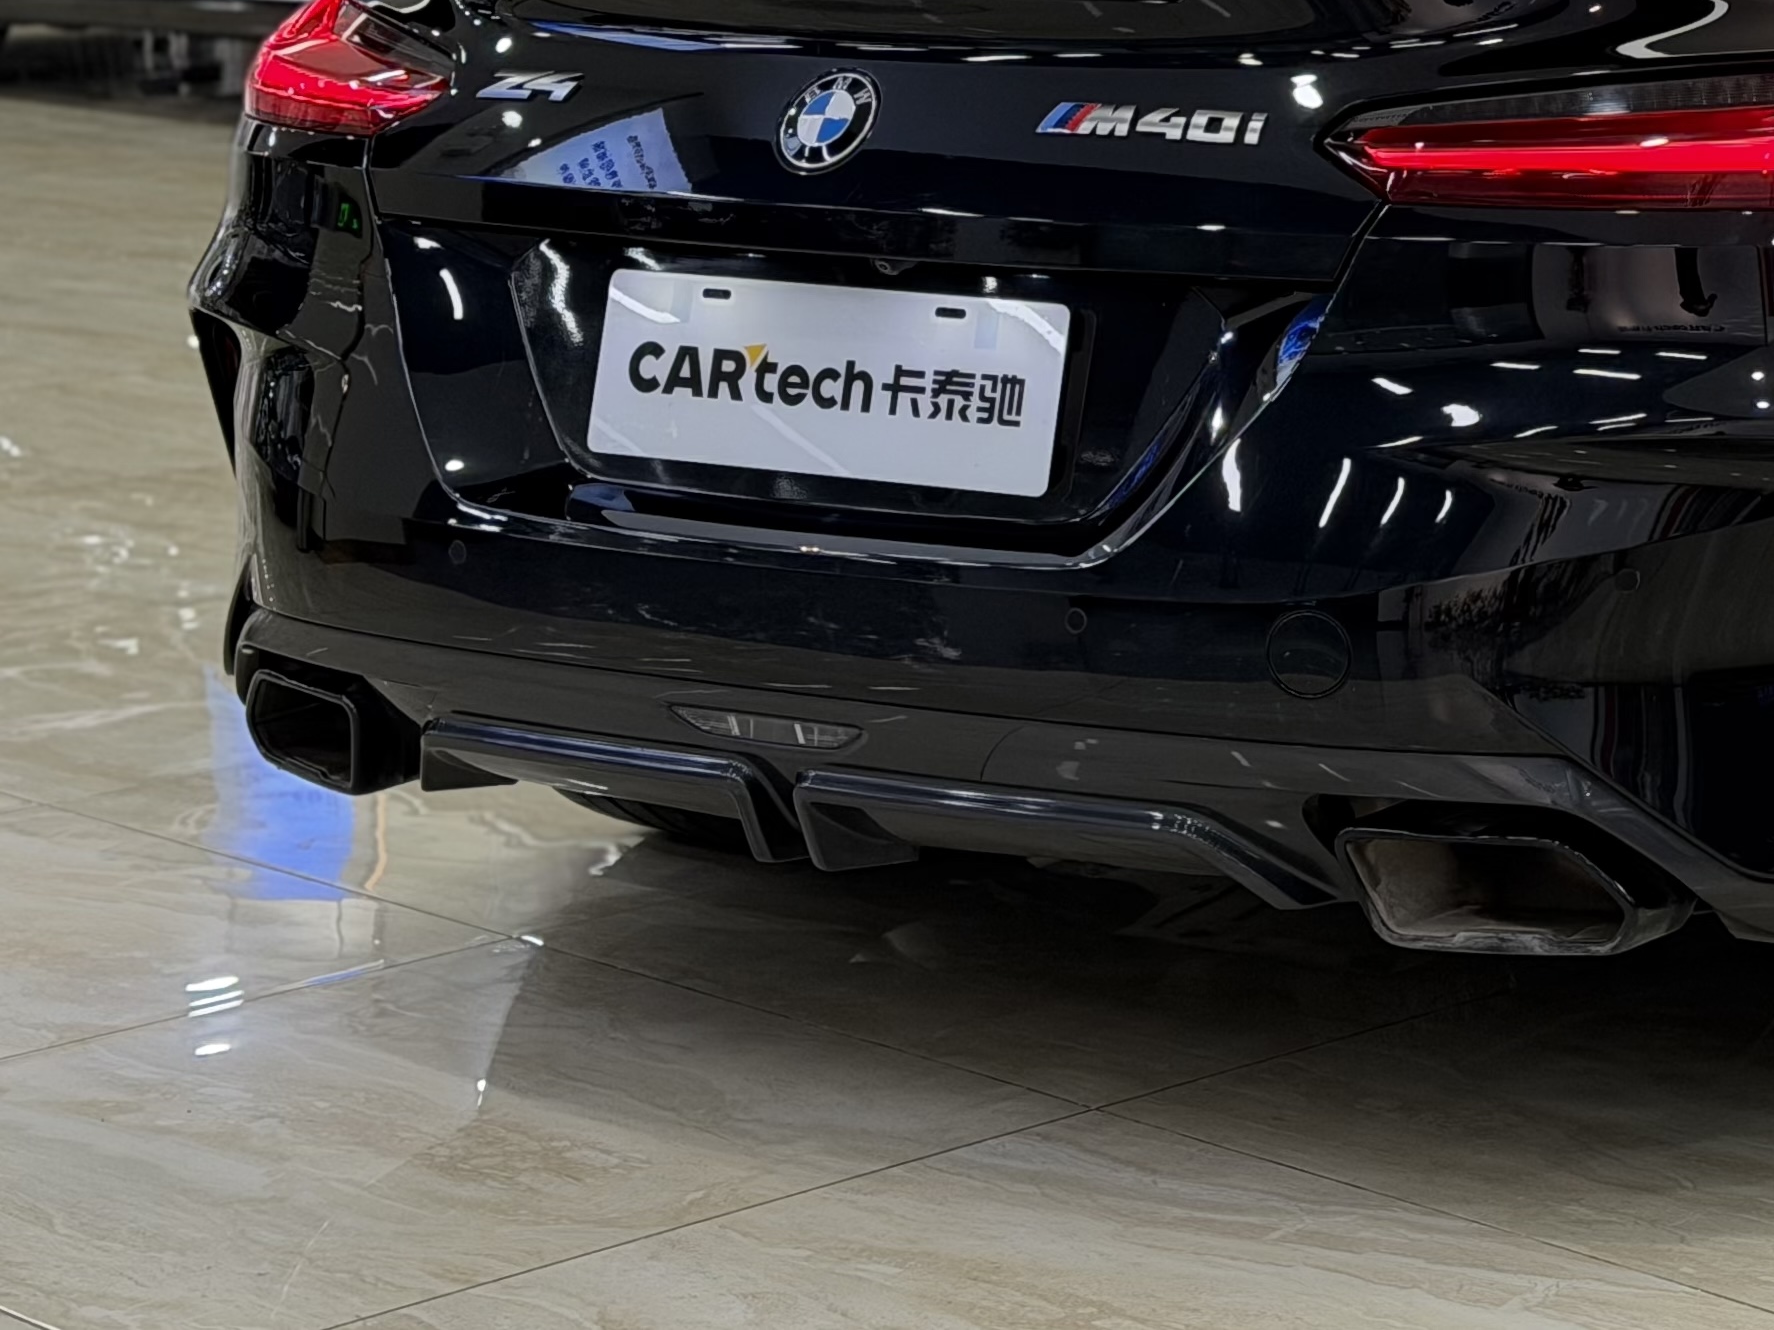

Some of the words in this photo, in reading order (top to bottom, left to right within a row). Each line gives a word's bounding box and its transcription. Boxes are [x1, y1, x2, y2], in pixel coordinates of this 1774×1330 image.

[475, 70, 584, 102] Z4
[803, 76, 872, 105] BMW
[1074, 103, 1268, 145] M40i
[628, 340, 874, 414] CARtech
[881, 364, 1026, 428] 卡泰驰
